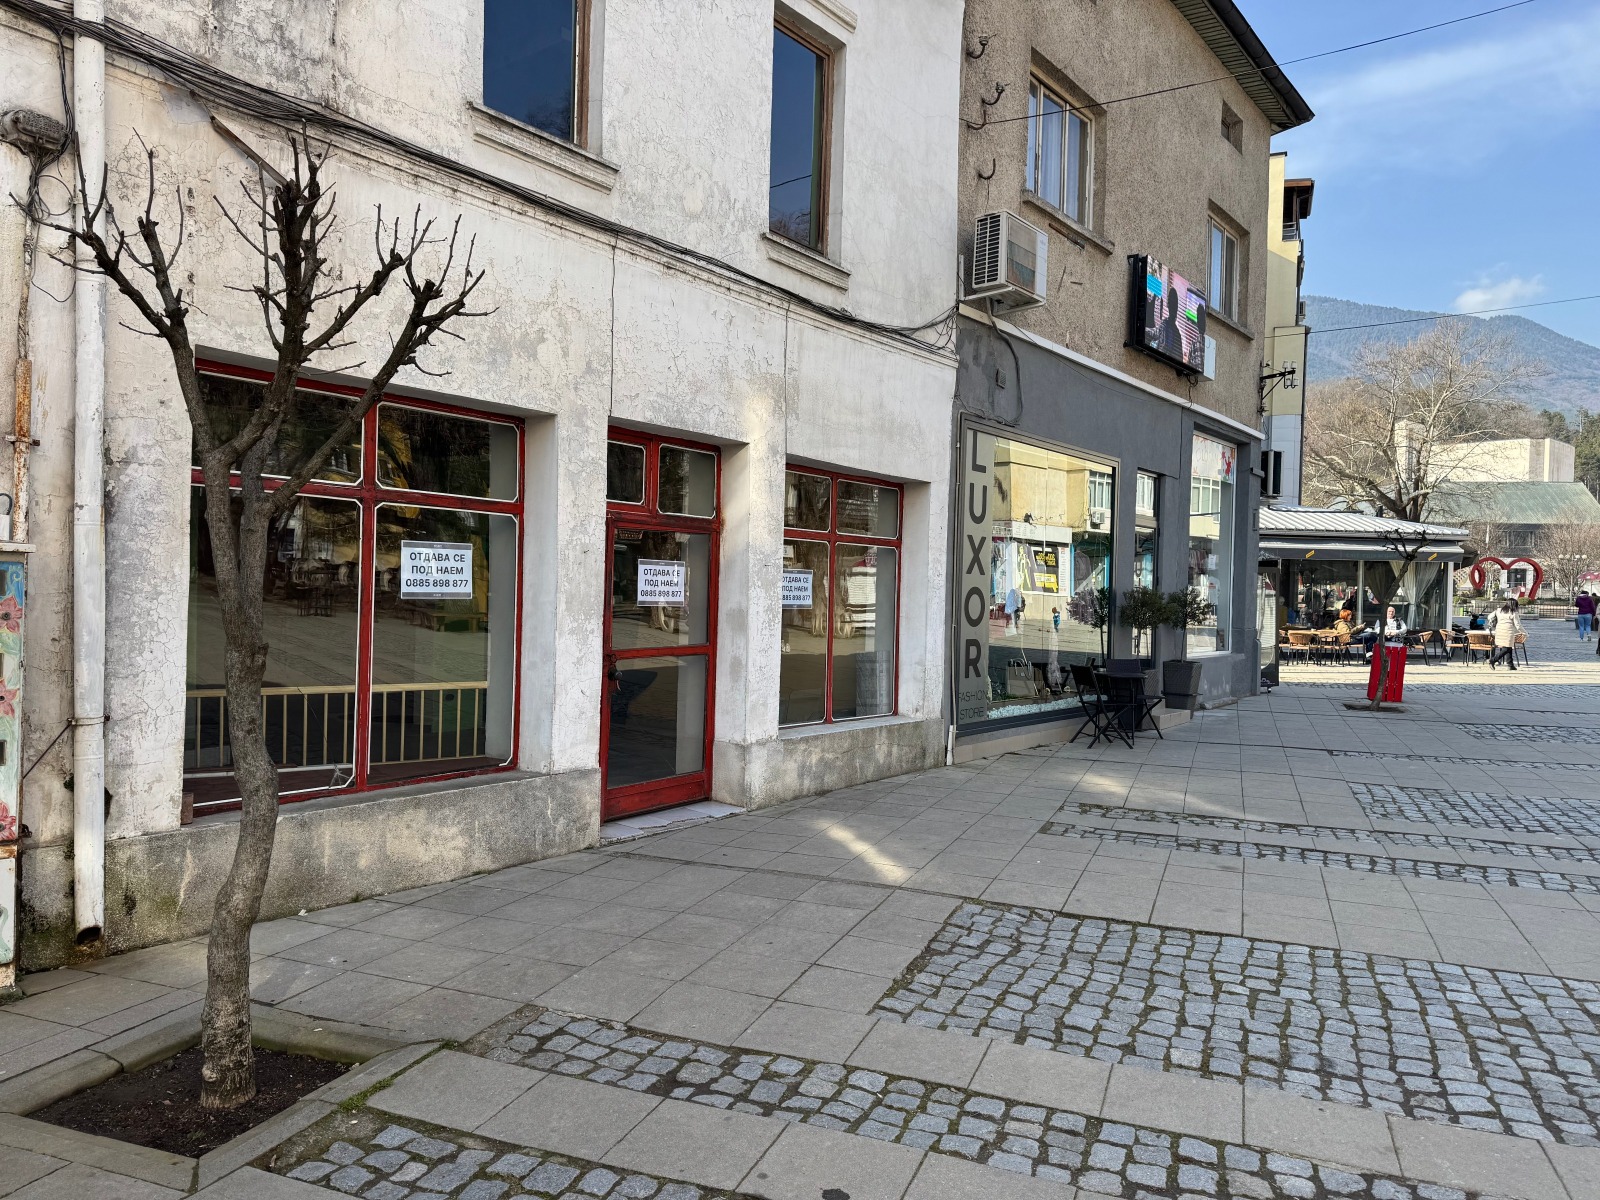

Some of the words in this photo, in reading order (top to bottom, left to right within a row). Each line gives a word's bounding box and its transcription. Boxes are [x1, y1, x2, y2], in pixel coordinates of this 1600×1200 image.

[410, 552, 450, 563] ОТДАВА
[453, 554, 465, 562] СЕ
[963, 430, 987, 679] LUXOR
[412, 566, 433, 576] ПОД
[436, 567, 463, 575] НАЕМ
[643, 569, 670, 577] ОТДАВА
[405, 579, 430, 587] 0885
[644, 579, 659, 587] ПОД
[959, 706, 985, 721] STORE
